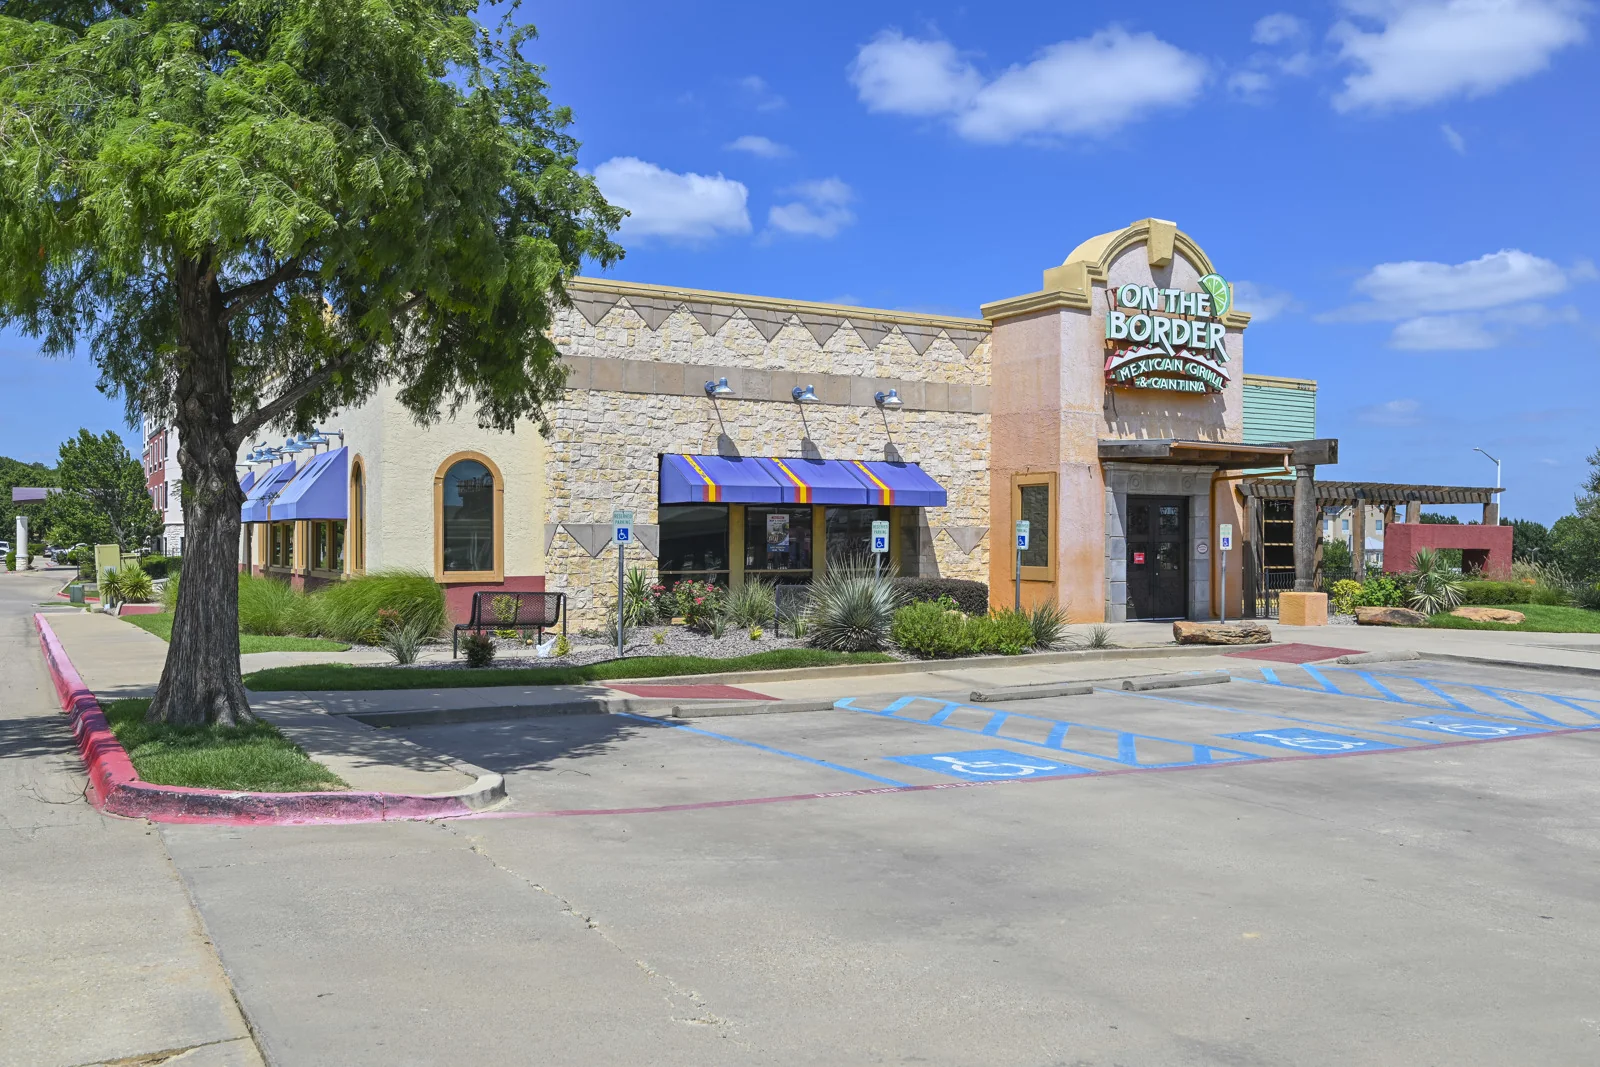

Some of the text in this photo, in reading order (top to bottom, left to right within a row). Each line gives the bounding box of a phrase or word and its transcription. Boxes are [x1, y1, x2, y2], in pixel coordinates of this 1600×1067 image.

[1119, 283, 1211, 317] ON THE
[1107, 311, 1231, 362] BORDER
[1119, 358, 1224, 390] MEXICAN GRILL
[1139, 376, 1207, 393] & CANTINA
